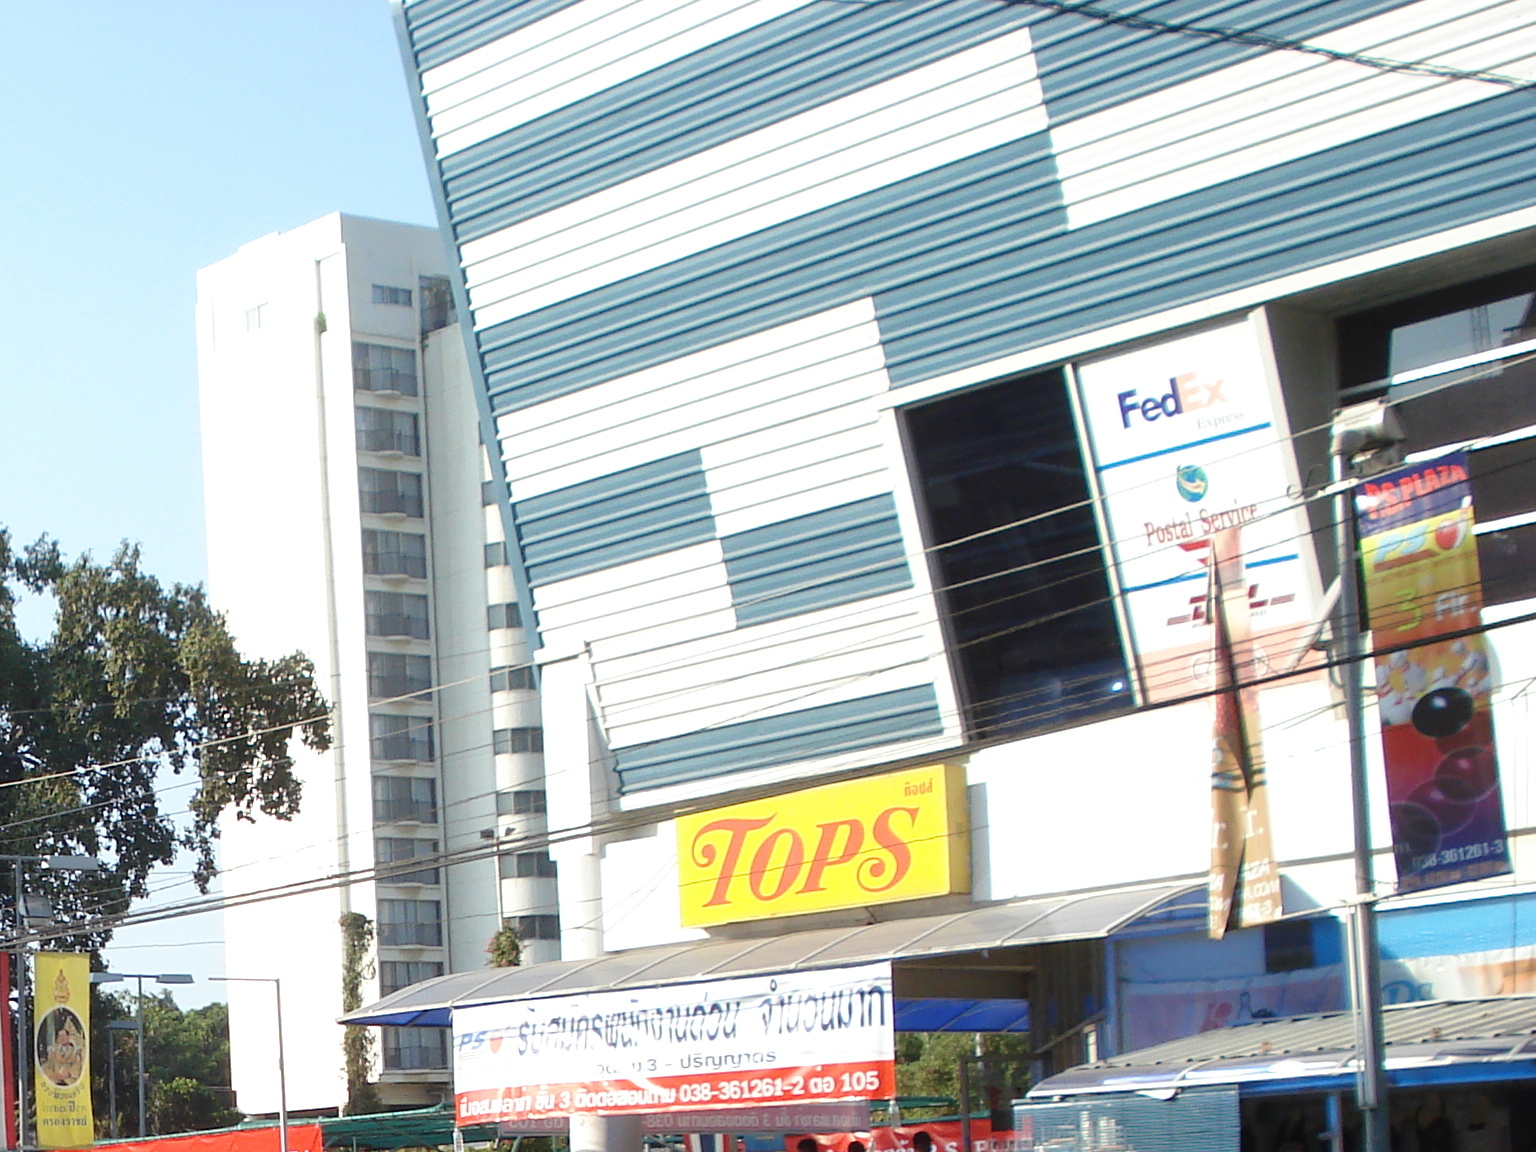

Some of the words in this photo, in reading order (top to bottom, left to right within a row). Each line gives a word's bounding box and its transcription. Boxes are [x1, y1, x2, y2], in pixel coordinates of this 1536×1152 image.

[1118, 372, 1228, 429] FedEx
[1197, 411, 1245, 430] Express
[1144, 511, 1193, 546] Postal
[1200, 500, 1258, 533] Service
[691, 806, 920, 908] TOPS
[759, 979, 886, 1035] จำนวนมาก
[559, 1090, 571, 1109] 3
[679, 1076, 805, 1102] 038-361261-2
[841, 1071, 880, 1093] 105
